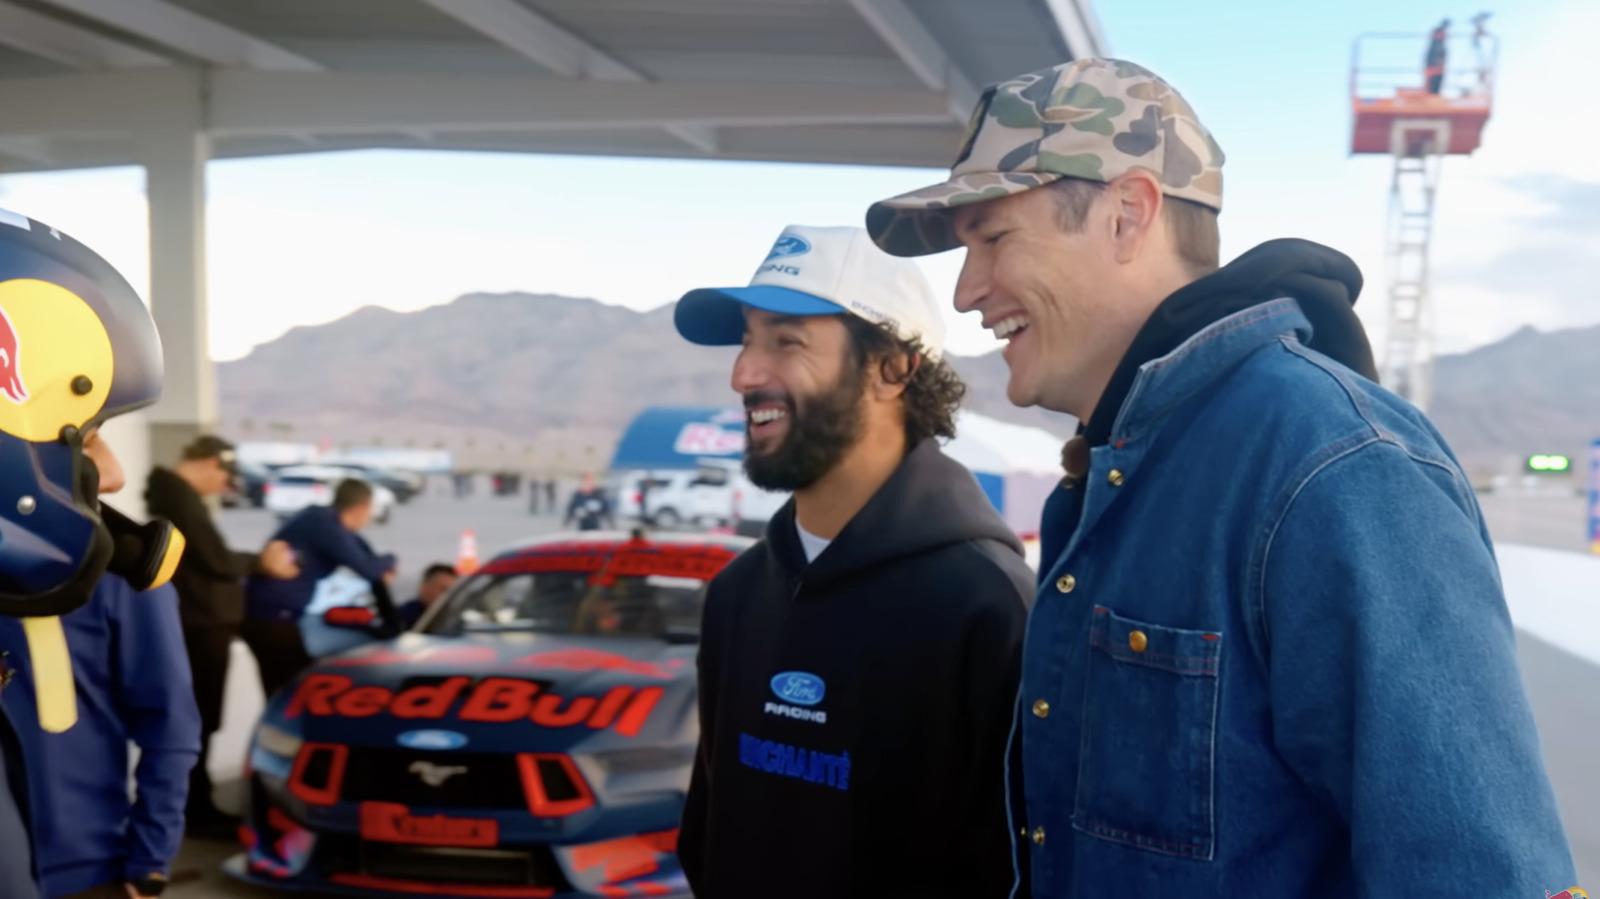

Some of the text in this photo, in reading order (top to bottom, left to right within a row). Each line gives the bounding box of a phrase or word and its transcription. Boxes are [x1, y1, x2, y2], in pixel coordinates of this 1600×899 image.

[284, 672, 664, 738] Red Bull
[764, 702, 827, 724] RACING
